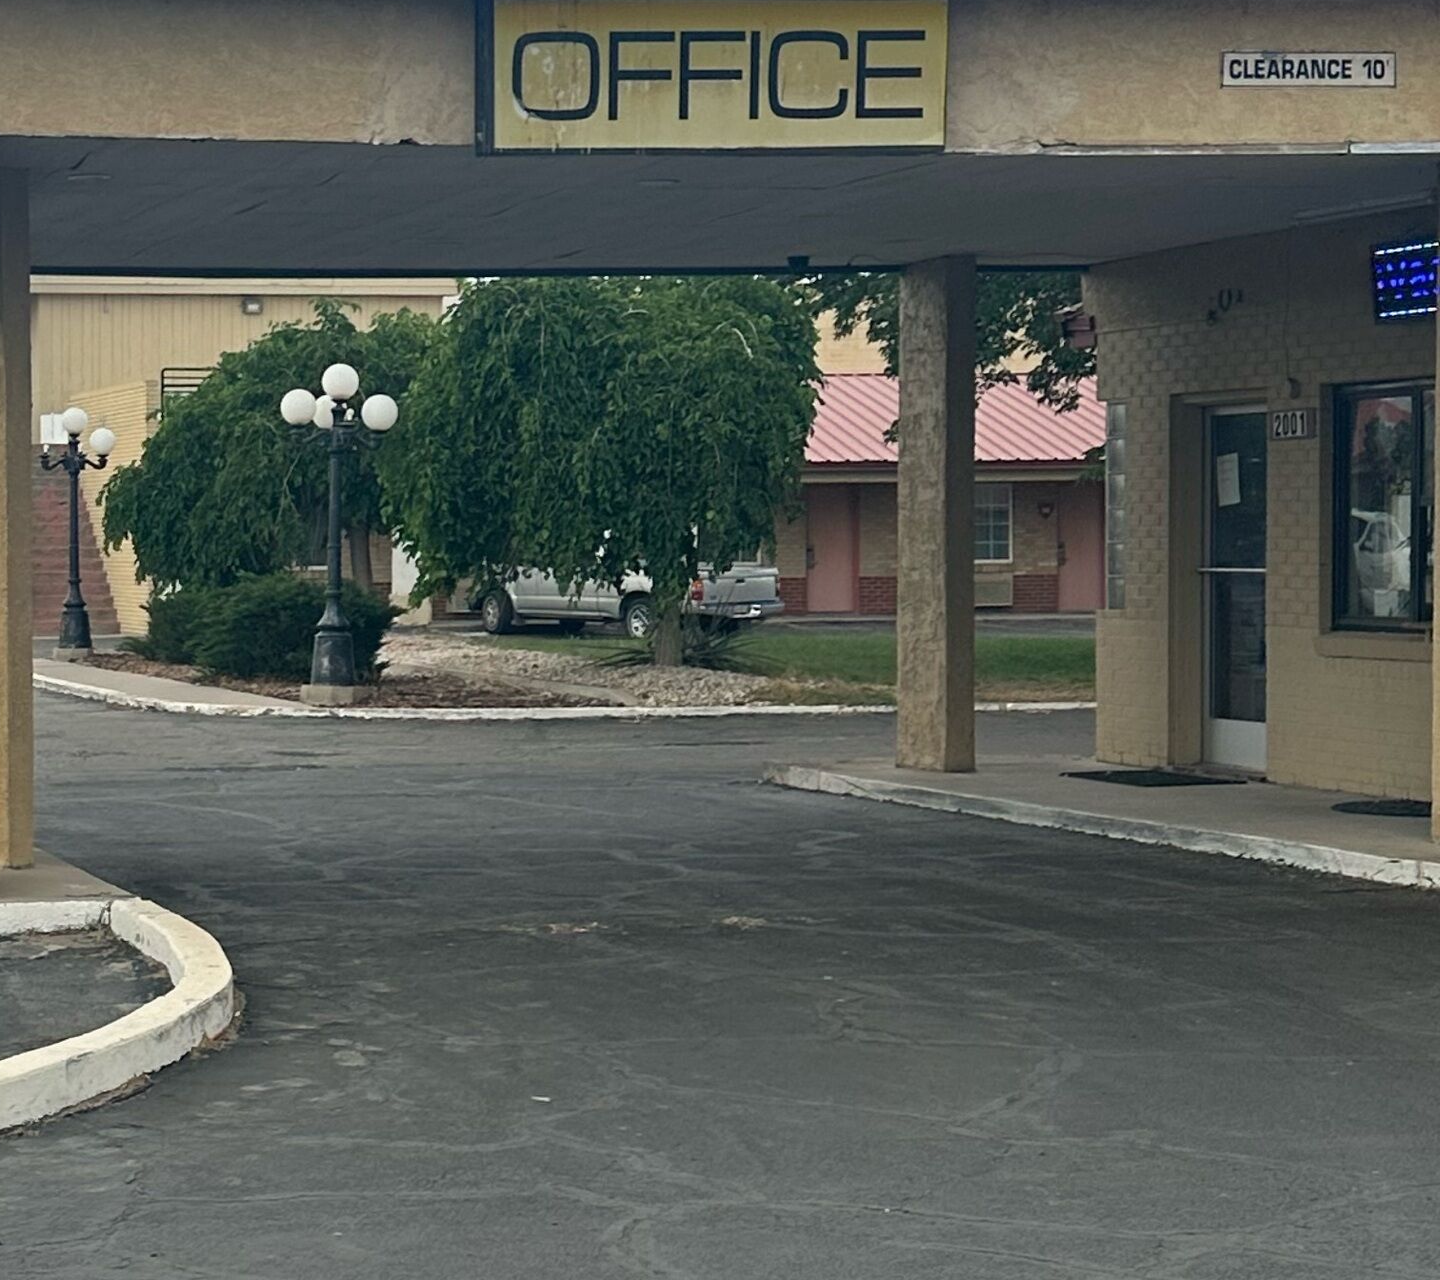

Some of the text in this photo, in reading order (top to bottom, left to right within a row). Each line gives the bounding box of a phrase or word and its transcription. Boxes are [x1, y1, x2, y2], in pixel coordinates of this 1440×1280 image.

[512, 29, 926, 120] OFFICE
[1229, 58, 1353, 80] CLEARANCE
[1274, 412, 1305, 437] 2001
